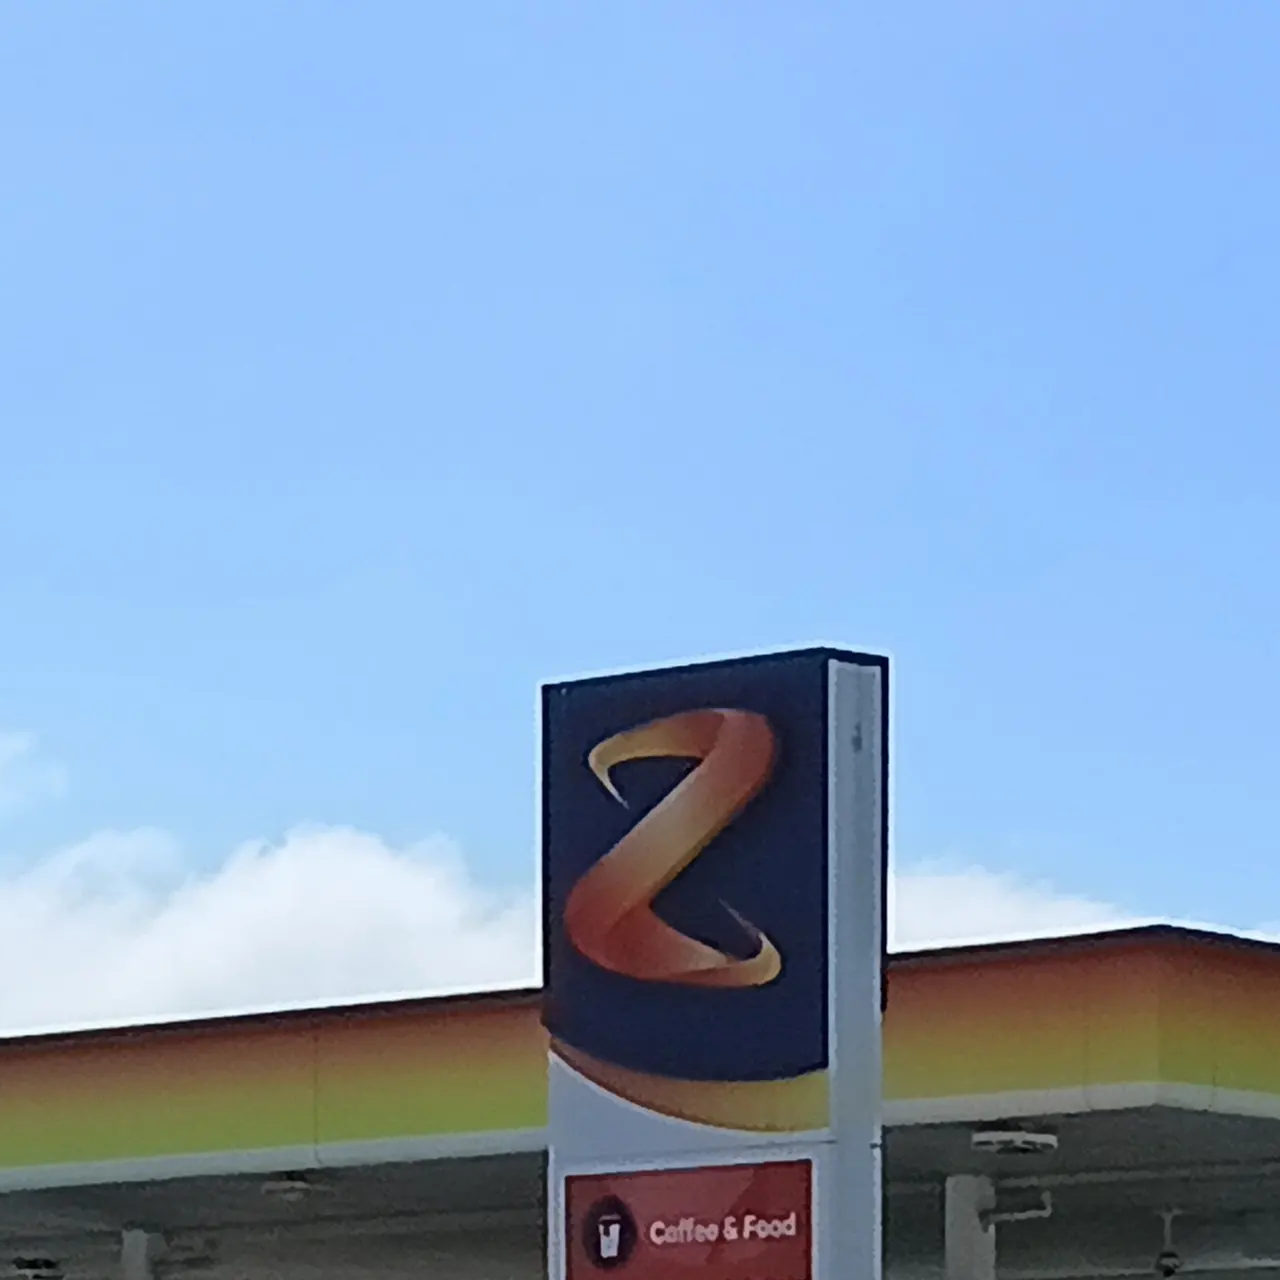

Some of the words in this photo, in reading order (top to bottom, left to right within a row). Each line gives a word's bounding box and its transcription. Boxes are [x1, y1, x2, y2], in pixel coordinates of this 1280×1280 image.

[564, 708, 782, 988] Z
[649, 1217, 719, 1245] Coffee
[723, 1216, 738, 1239] &
[742, 1212, 797, 1239] Food
